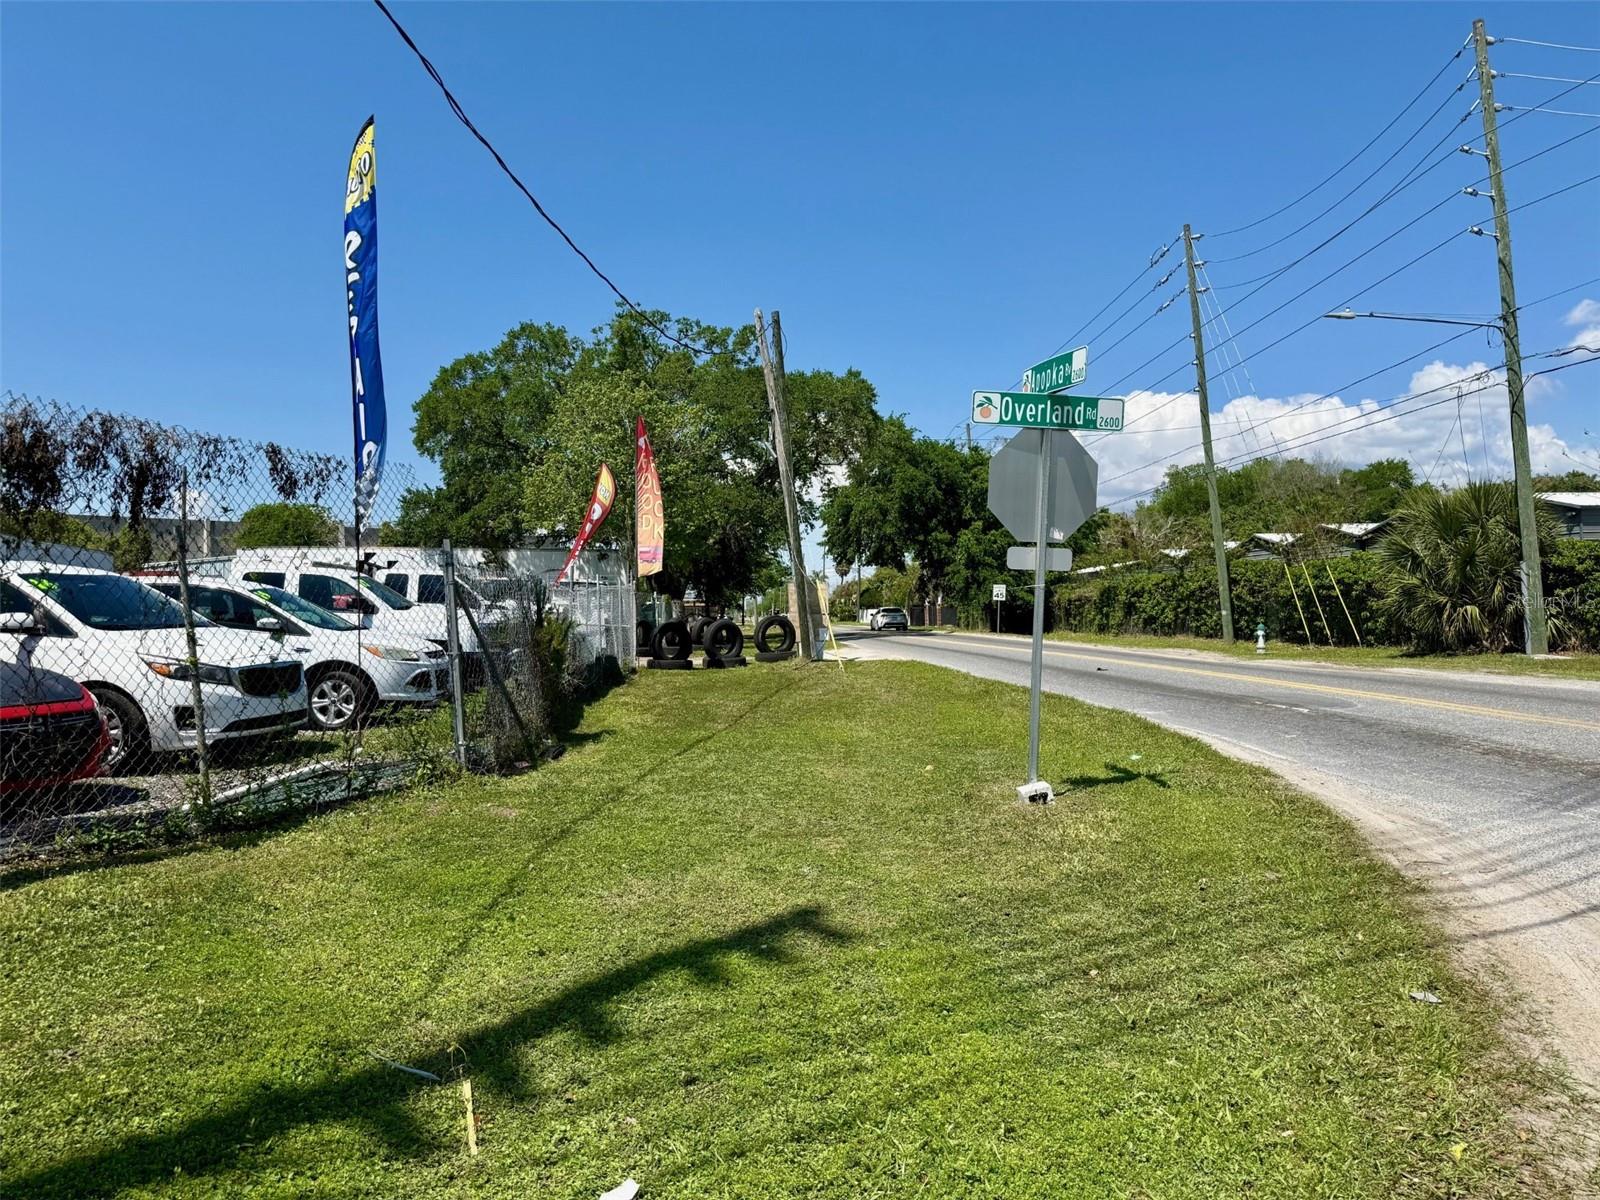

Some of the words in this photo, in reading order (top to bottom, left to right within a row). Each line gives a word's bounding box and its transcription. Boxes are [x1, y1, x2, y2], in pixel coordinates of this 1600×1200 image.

[1001, 396, 1085, 425] Overland
[1086, 406, 1097, 420] Rd
[1098, 416, 1120, 428] 2600
